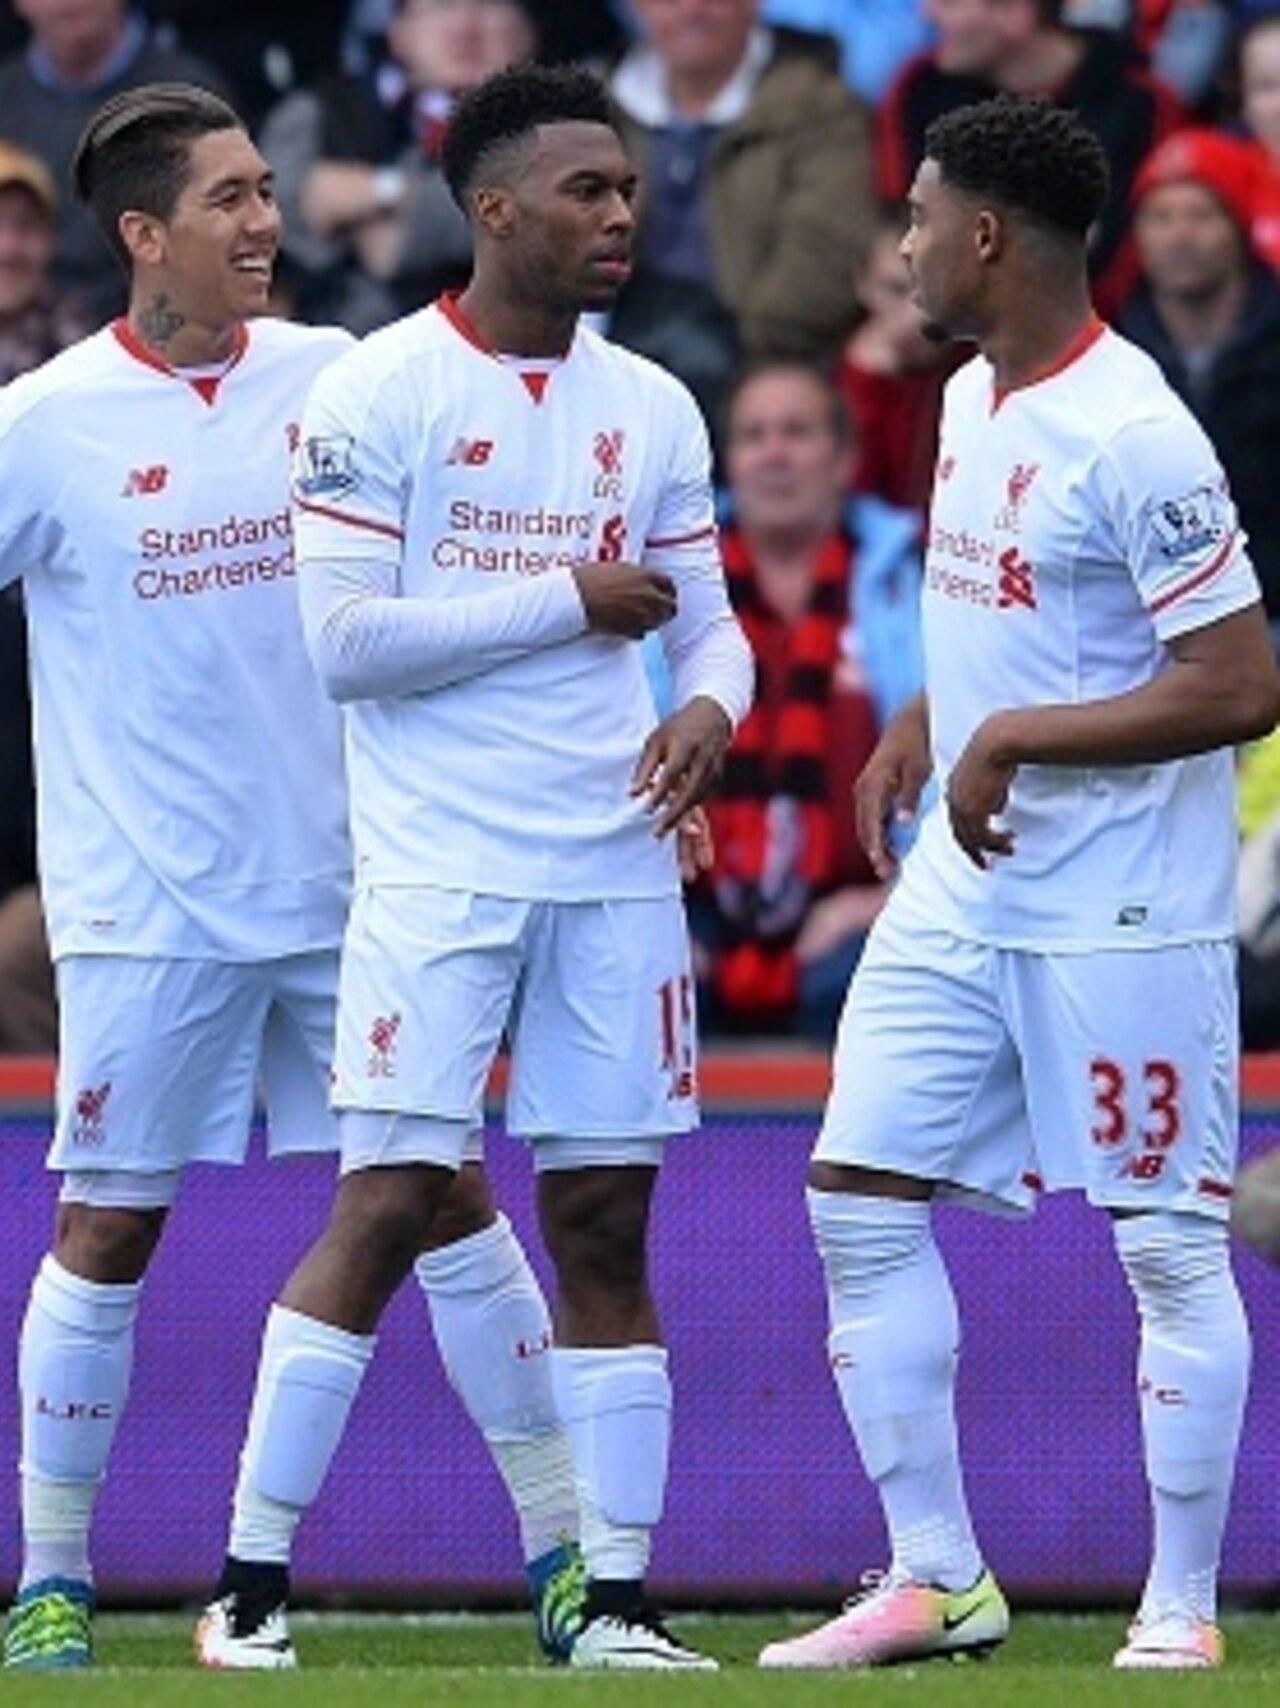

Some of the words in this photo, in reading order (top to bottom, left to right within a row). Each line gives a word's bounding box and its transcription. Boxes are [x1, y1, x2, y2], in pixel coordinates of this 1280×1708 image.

[138, 507, 294, 561] Standard
[450, 500, 595, 540] Standard
[132, 545, 297, 601] Chartered
[1089, 1058, 1180, 1149] 33
